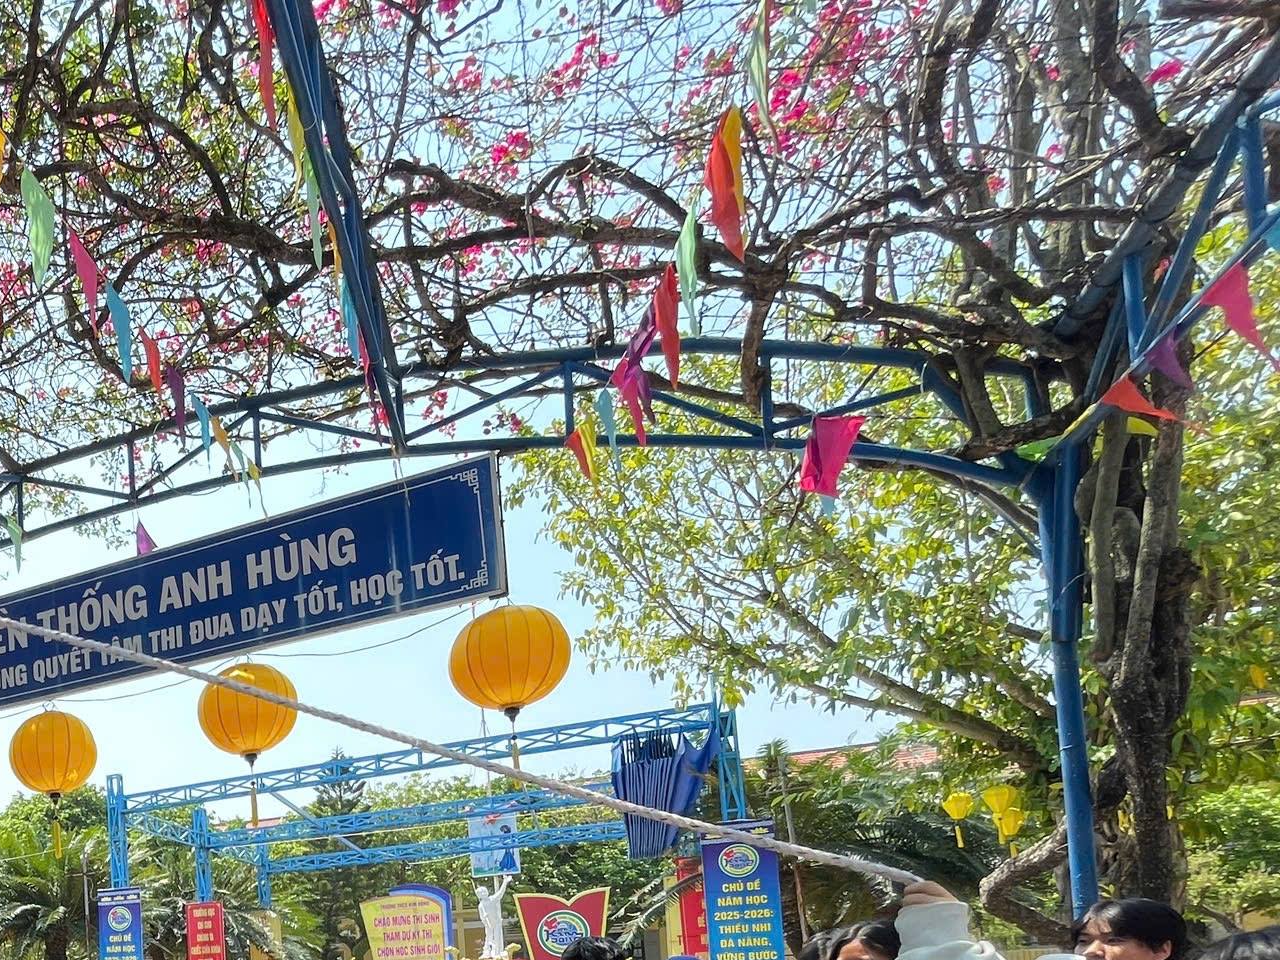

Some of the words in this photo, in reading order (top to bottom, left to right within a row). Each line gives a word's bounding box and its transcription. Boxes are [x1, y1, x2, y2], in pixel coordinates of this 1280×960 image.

[36, 581, 148, 643] THỐNG
[158, 559, 233, 614] ANH
[246, 527, 357, 590] HÙNG
[148, 624, 184, 654] THI
[190, 612, 235, 645] ĐUA
[241, 598, 287, 633] DẠY
[294, 580, 343, 619] TỐT,
[350, 569, 404, 606] HỌC
[411, 548, 466, 590] TỐT.
[722, 880, 745, 893] CHỦ
[745, 894, 768, 906] HỌC
[714, 908, 774, 921] 2025-2026:
[752, 922, 771, 932] NHI
